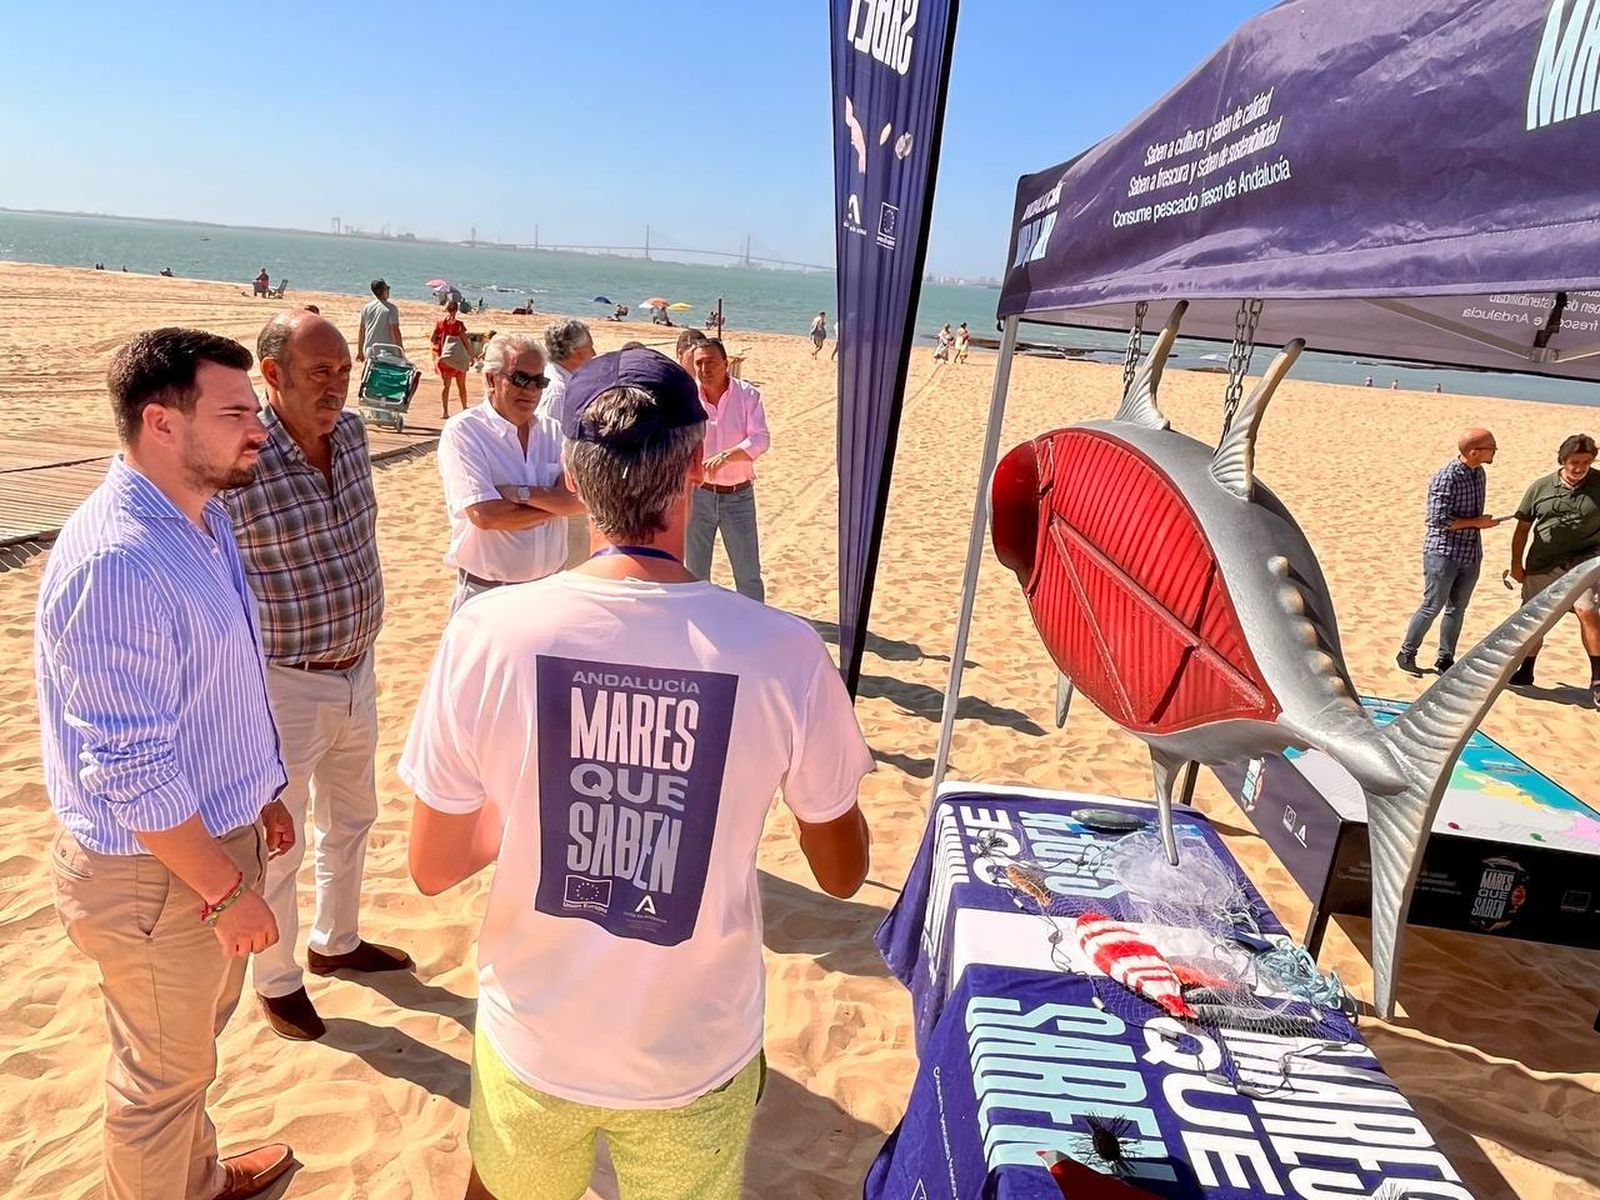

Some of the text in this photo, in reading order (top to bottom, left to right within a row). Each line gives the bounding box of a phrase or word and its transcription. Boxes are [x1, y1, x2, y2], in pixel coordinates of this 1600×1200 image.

[1144, 137, 1169, 167] Saben
[1174, 127, 1205, 157] cultura
[1204, 126, 1213, 150] y
[1211, 115, 1233, 143] saben
[1232, 105, 1242, 129] de
[1242, 86, 1275, 124] calidad
[1112, 205, 1152, 229] Consume
[1153, 191, 1200, 224] pescado
[1224, 175, 1237, 199] de
[1238, 154, 1292, 195] Andalucía
[1128, 170, 1151, 197] Saben
[1156, 163, 1189, 190] frescura
[1188, 161, 1198, 185] y
[1218, 142, 1228, 168] de
[572, 670, 701, 695] ANDALUCÍA
[570, 687, 700, 772] MARES
[570, 762, 689, 812] QUE
[566, 801, 682, 894] SABEN
[1471, 897, 1506, 919] SABEN
[1478, 888, 1509, 900] QUE
[1480, 871, 1515, 892] MARES
[964, 996, 1179, 1183] SABEN
[1141, 1017, 1284, 1196] QUE
